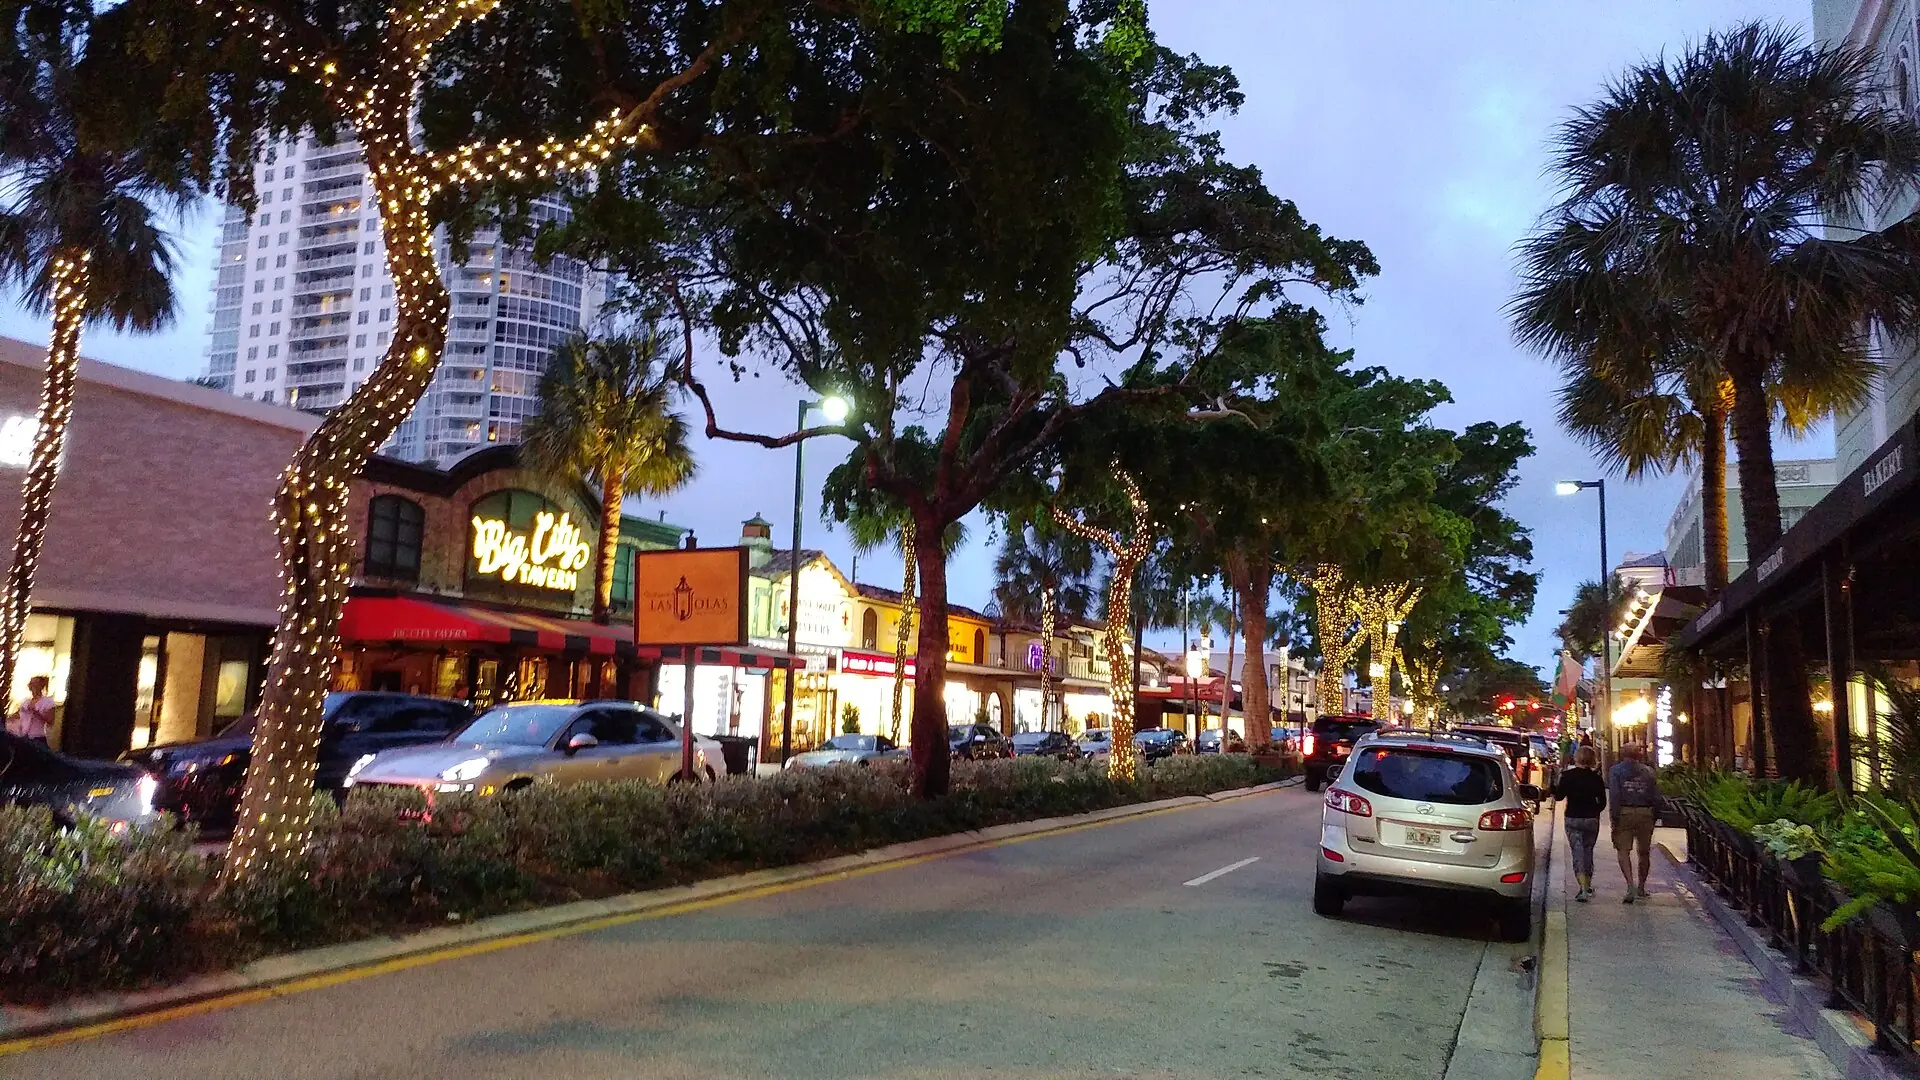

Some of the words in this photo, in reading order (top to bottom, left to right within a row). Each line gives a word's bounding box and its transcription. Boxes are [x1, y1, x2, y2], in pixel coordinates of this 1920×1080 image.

[1862, 444, 1905, 498] BAKERY
[472, 515, 529, 581] Big
[530, 511, 590, 570] City
[519, 563, 577, 591] TAVERN
[694, 598, 728, 610] OLAS
